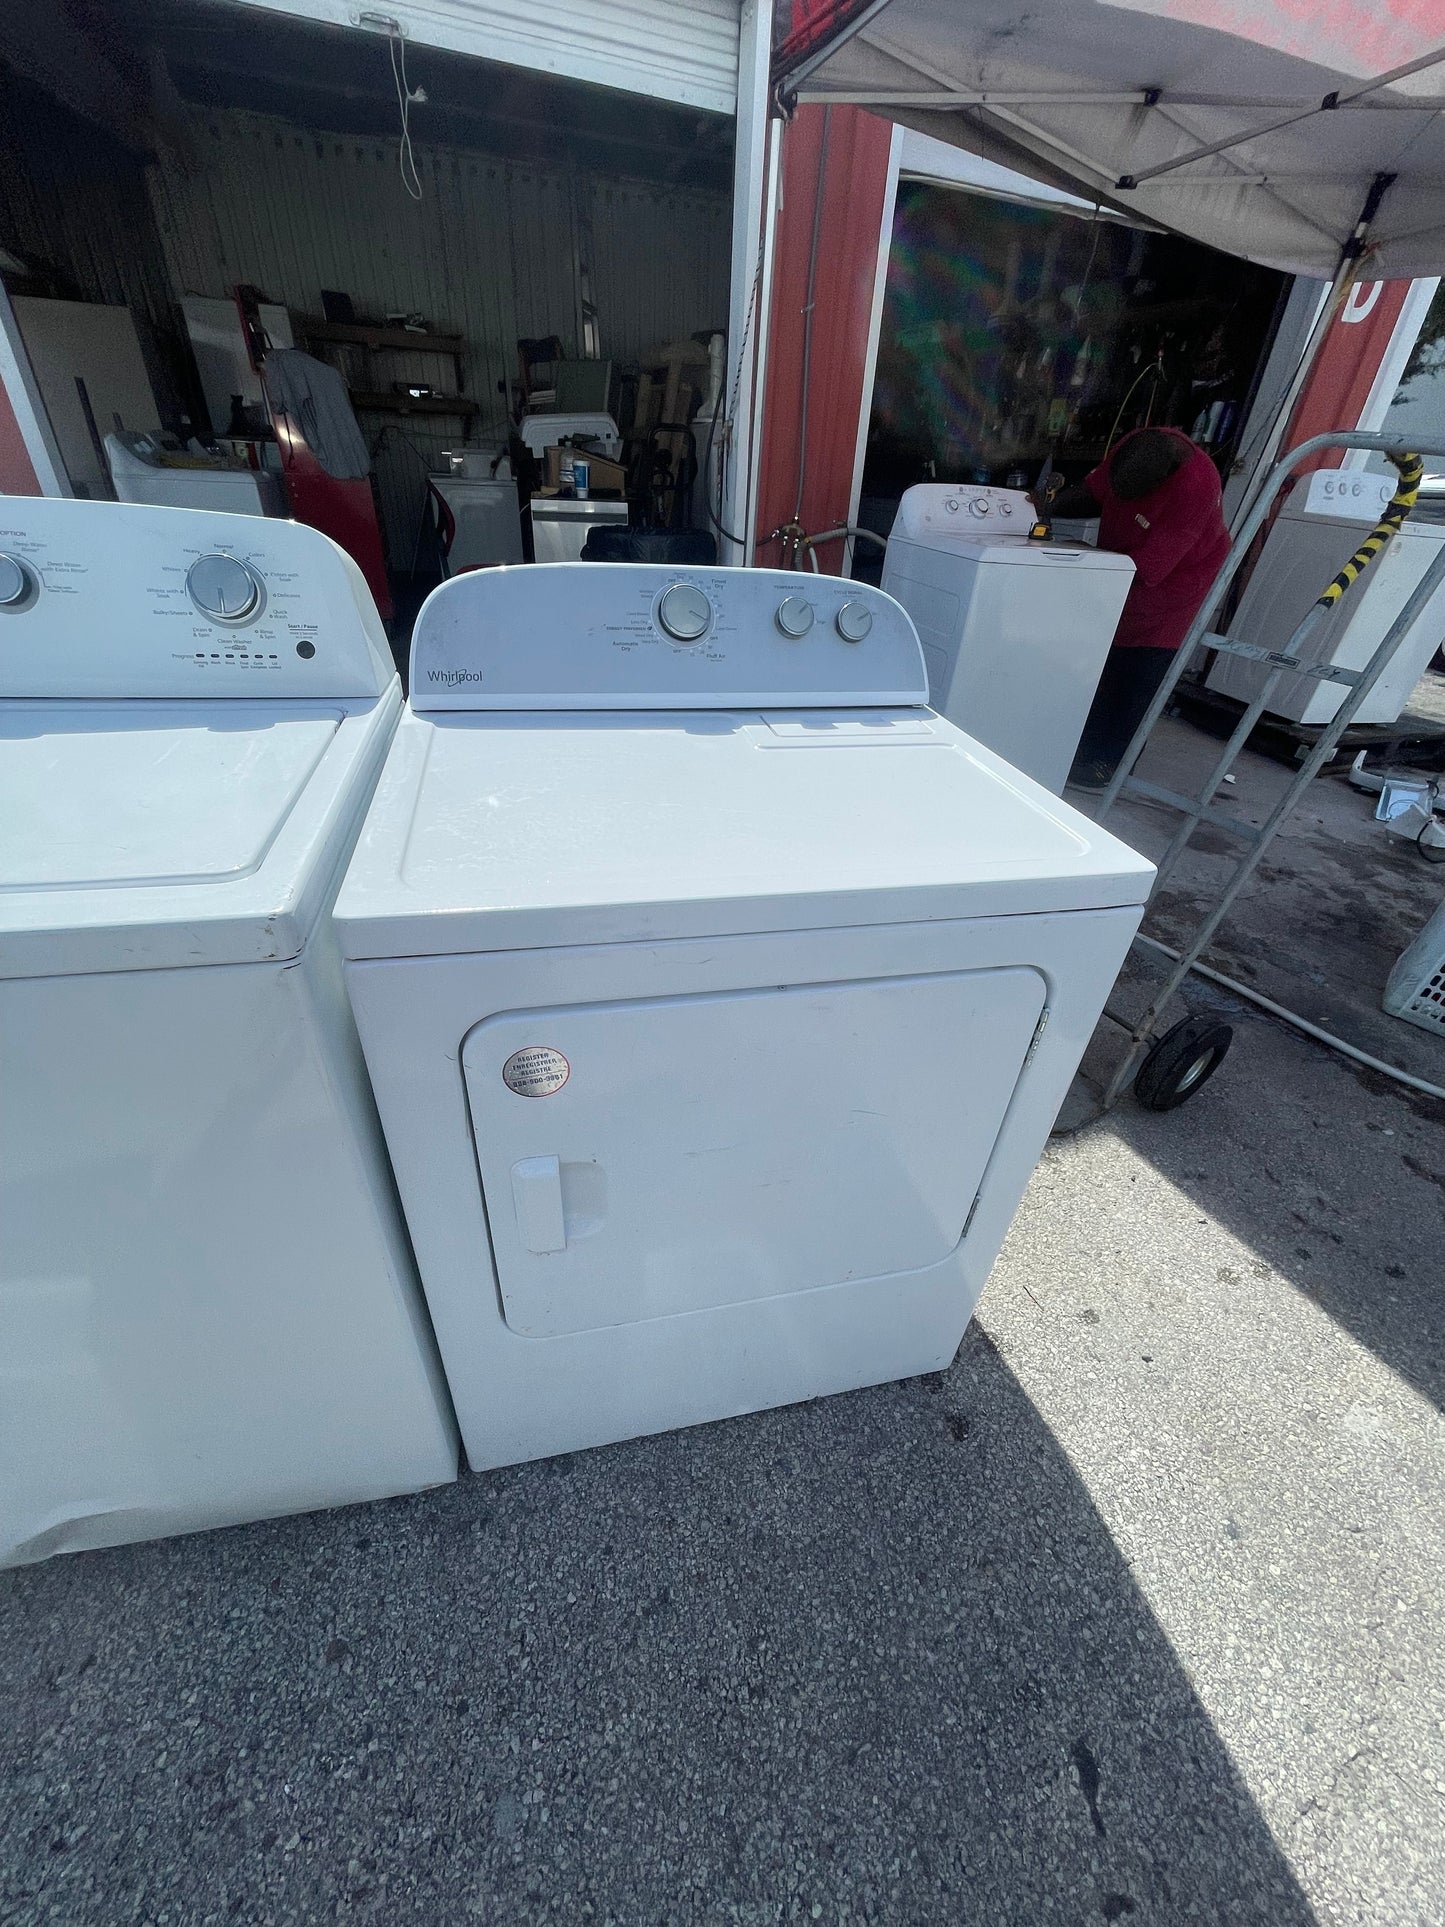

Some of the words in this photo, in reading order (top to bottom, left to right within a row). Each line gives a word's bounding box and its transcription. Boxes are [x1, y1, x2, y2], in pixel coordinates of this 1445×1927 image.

[426, 669, 483, 687] Whirlpool
[517, 1052, 549, 1063] REGISTER
[512, 1058, 558, 1071] ENREGISTRER
[521, 1066, 552, 1077] REGISTRE
